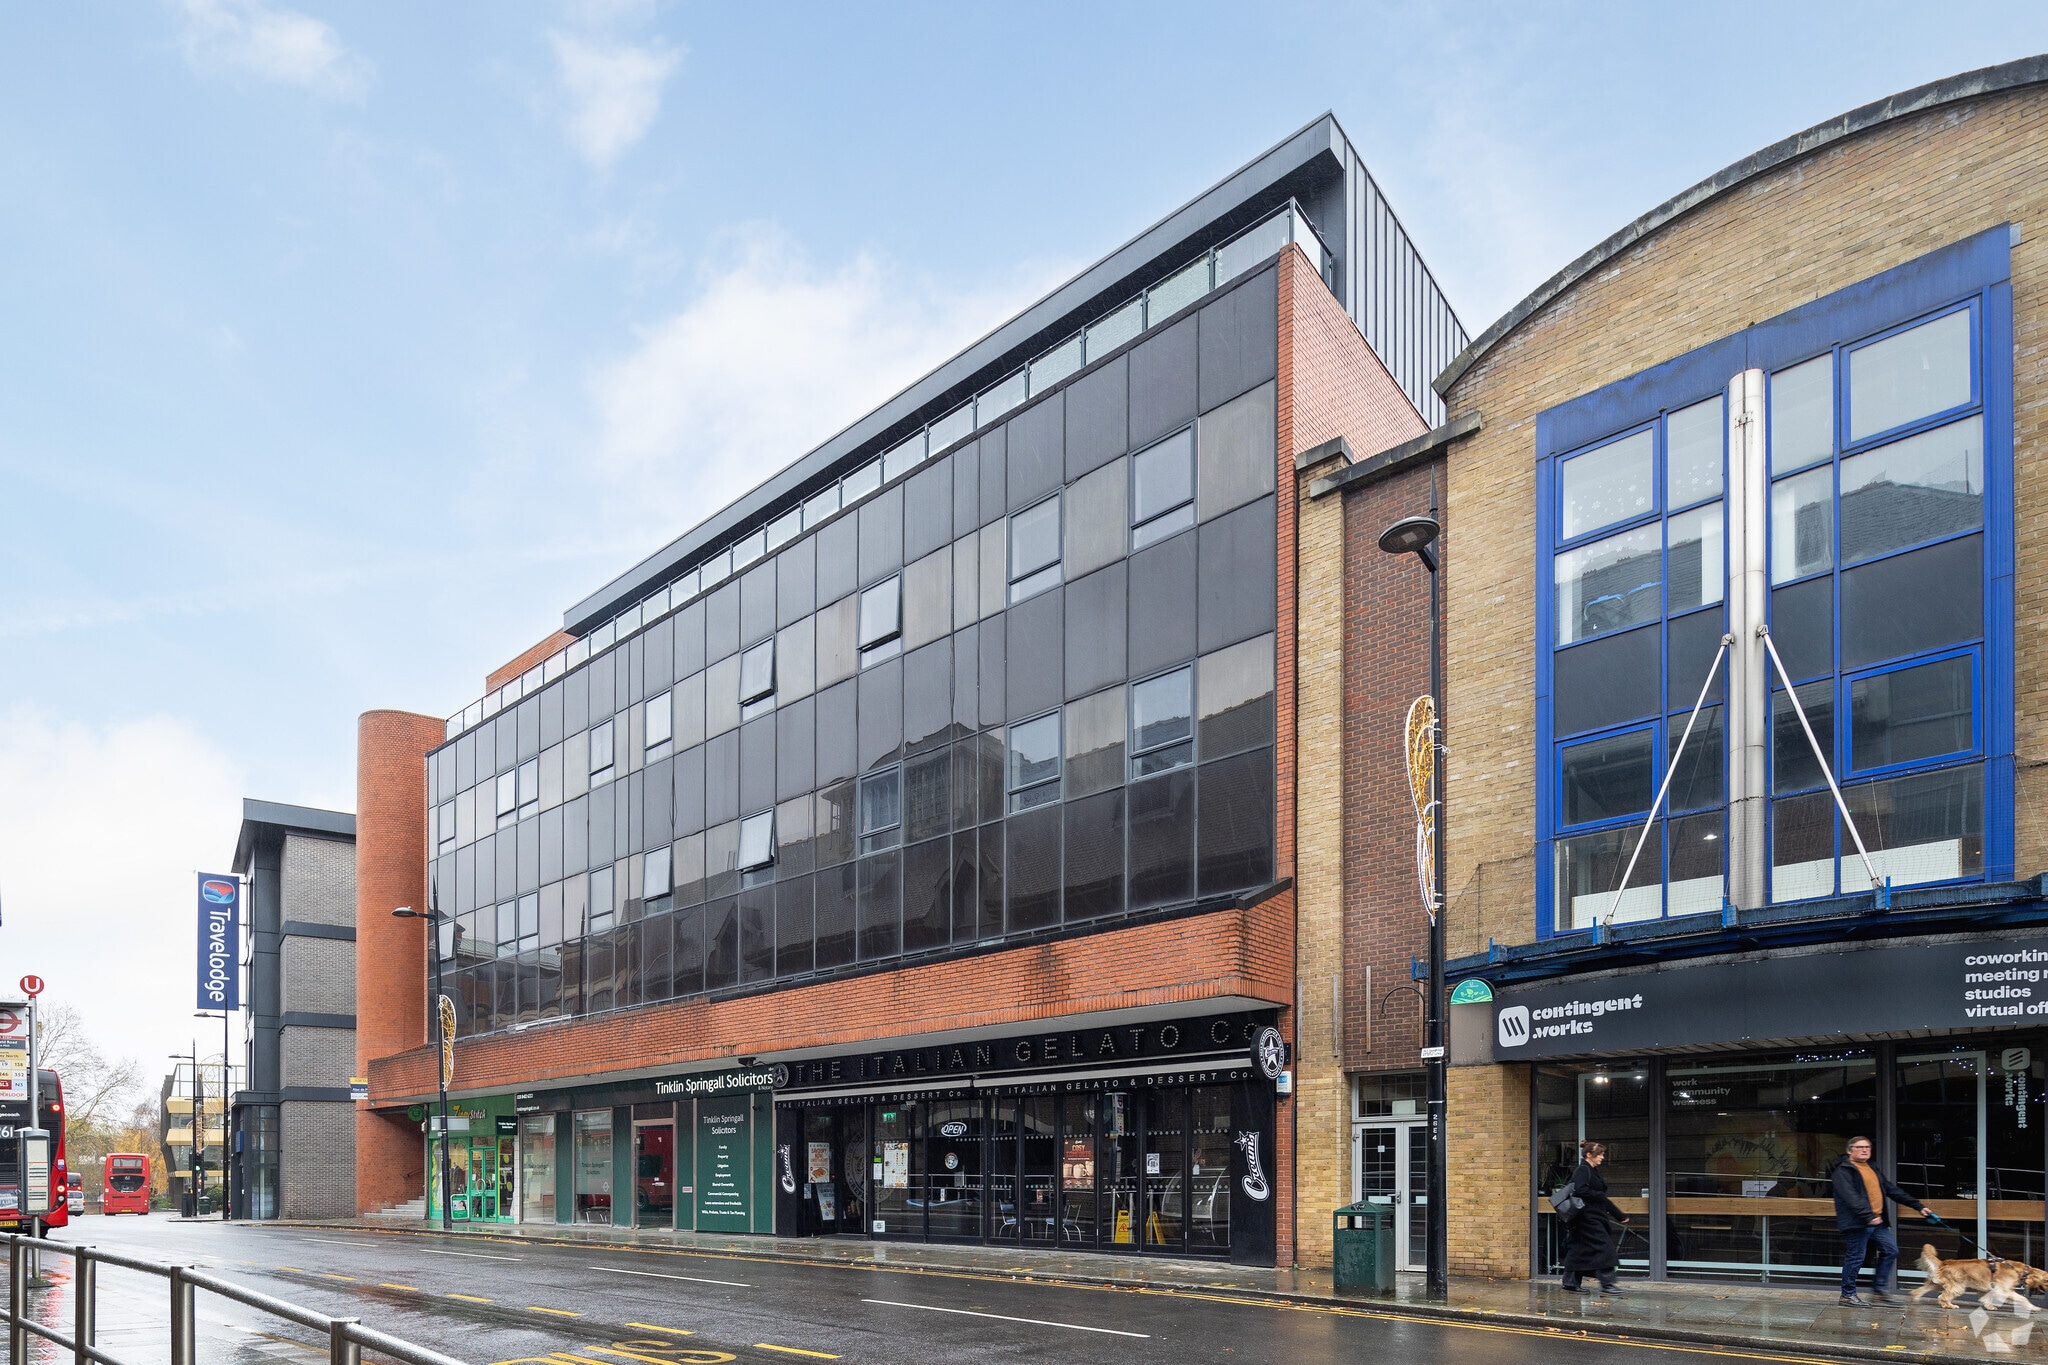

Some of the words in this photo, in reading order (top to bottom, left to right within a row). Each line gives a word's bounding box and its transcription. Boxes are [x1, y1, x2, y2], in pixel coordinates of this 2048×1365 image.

[204, 907, 231, 1002] Travelodge
[1965, 967, 2040, 982] meeting
[24, 977, 41, 992] U
[1965, 985, 2032, 1000] studios
[1532, 993, 1643, 1021] contingent
[1965, 1002, 2024, 1018] virtual
[796, 1061, 841, 1082] THE
[860, 1045, 991, 1077] ITALIAN
[1015, 1025, 1179, 1062] GELATO
[656, 1081, 684, 1095] Tinklin
[685, 1077, 725, 1094] Springall
[726, 1072, 774, 1089] Solicitors
[979, 1088, 999, 1096] THE
[1008, 1084, 1057, 1094] ITALIAN
[1066, 1079, 1119, 1091] GELATO
[1130, 1078, 1136, 1086] &
[1147, 1072, 1217, 1085] DESSERT
[1672, 1078, 1698, 1087] work
[799, 1099, 832, 1107] ITALIAN
[838, 1096, 875, 1104] GELATO
[893, 1091, 941, 1100] DESSERT
[1672, 1098, 1717, 1106] wellness
[2015, 1071, 2028, 1129] contingent
[703, 1116, 720, 1124] Tinklin
[721, 1113, 744, 1124] Springall
[0, 1124, 14, 1138] 61
[711, 1126, 737, 1135] Solicitors
[942, 1124, 964, 1134] OPEN
